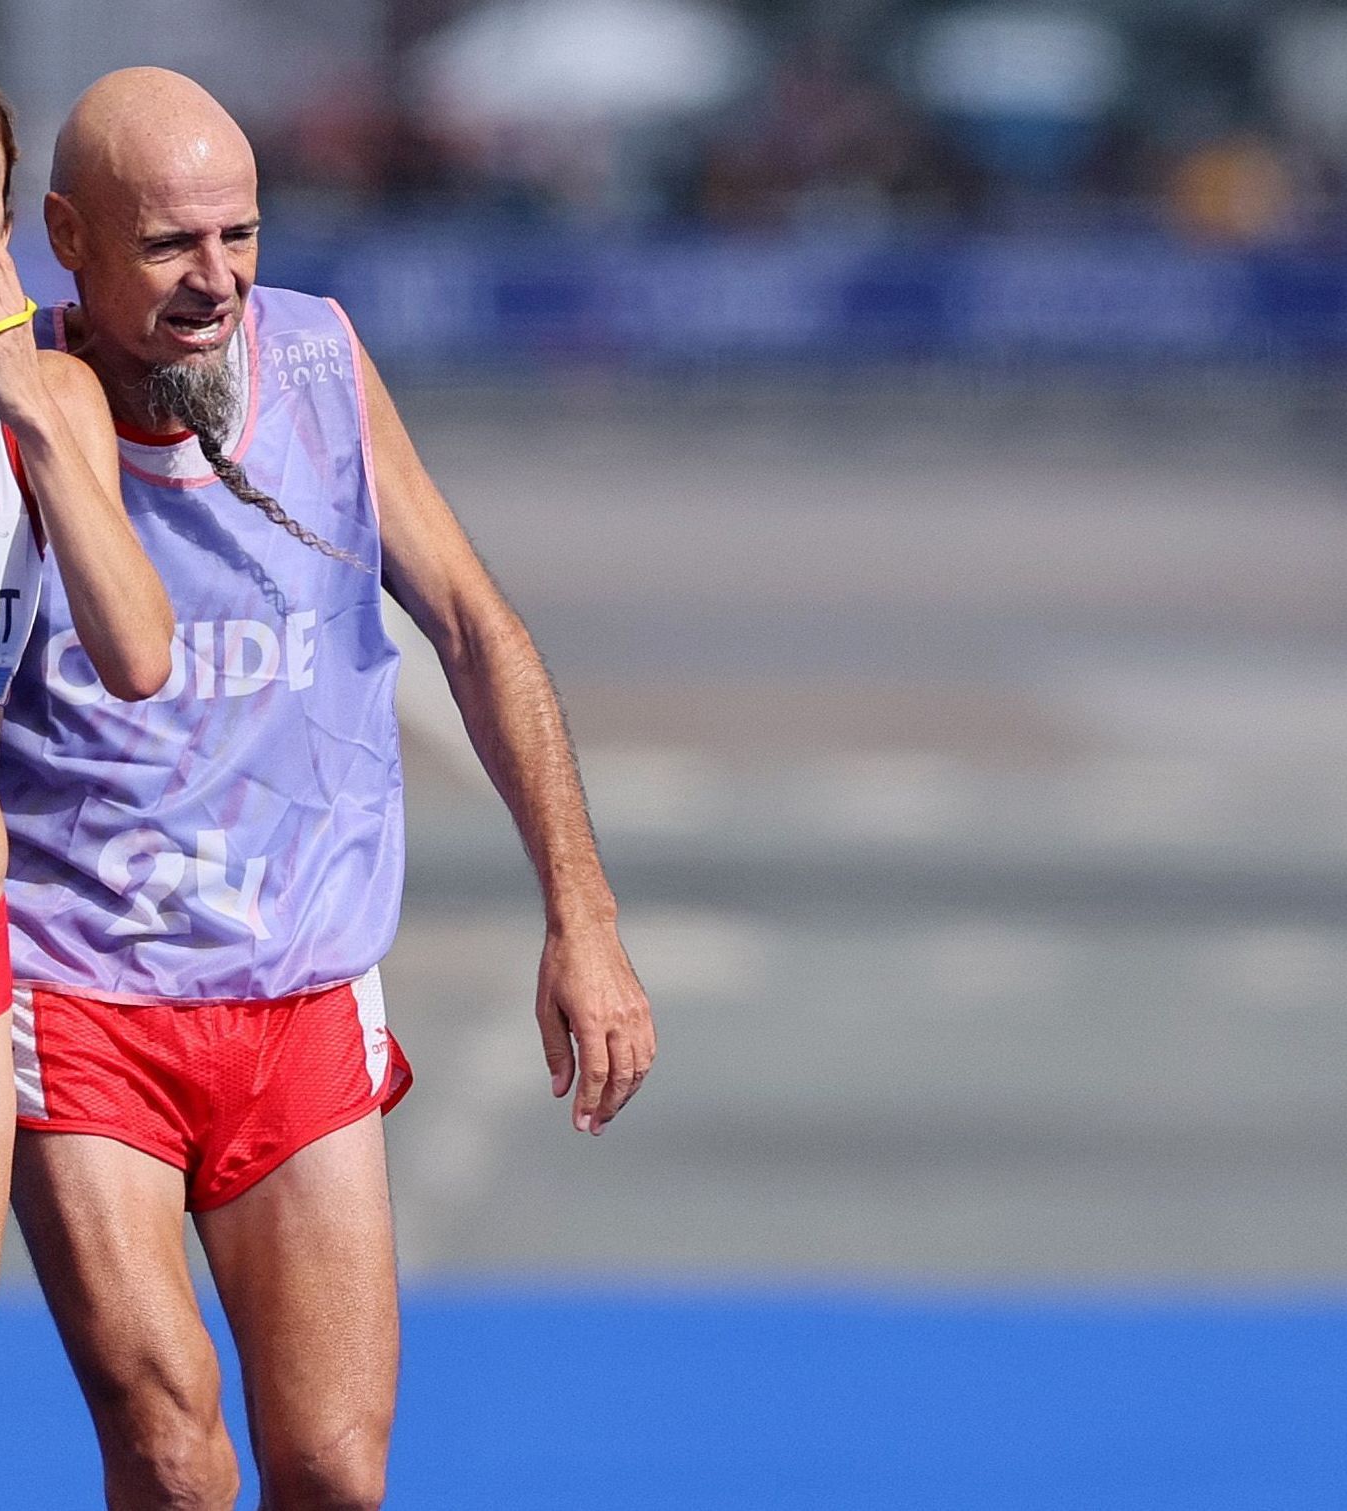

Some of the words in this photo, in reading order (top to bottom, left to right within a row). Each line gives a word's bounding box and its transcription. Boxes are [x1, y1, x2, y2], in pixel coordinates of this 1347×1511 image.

[272, 338, 340, 367] PARIS
[278, 361, 343, 391] 2024
[97, 827, 271, 940] 24
